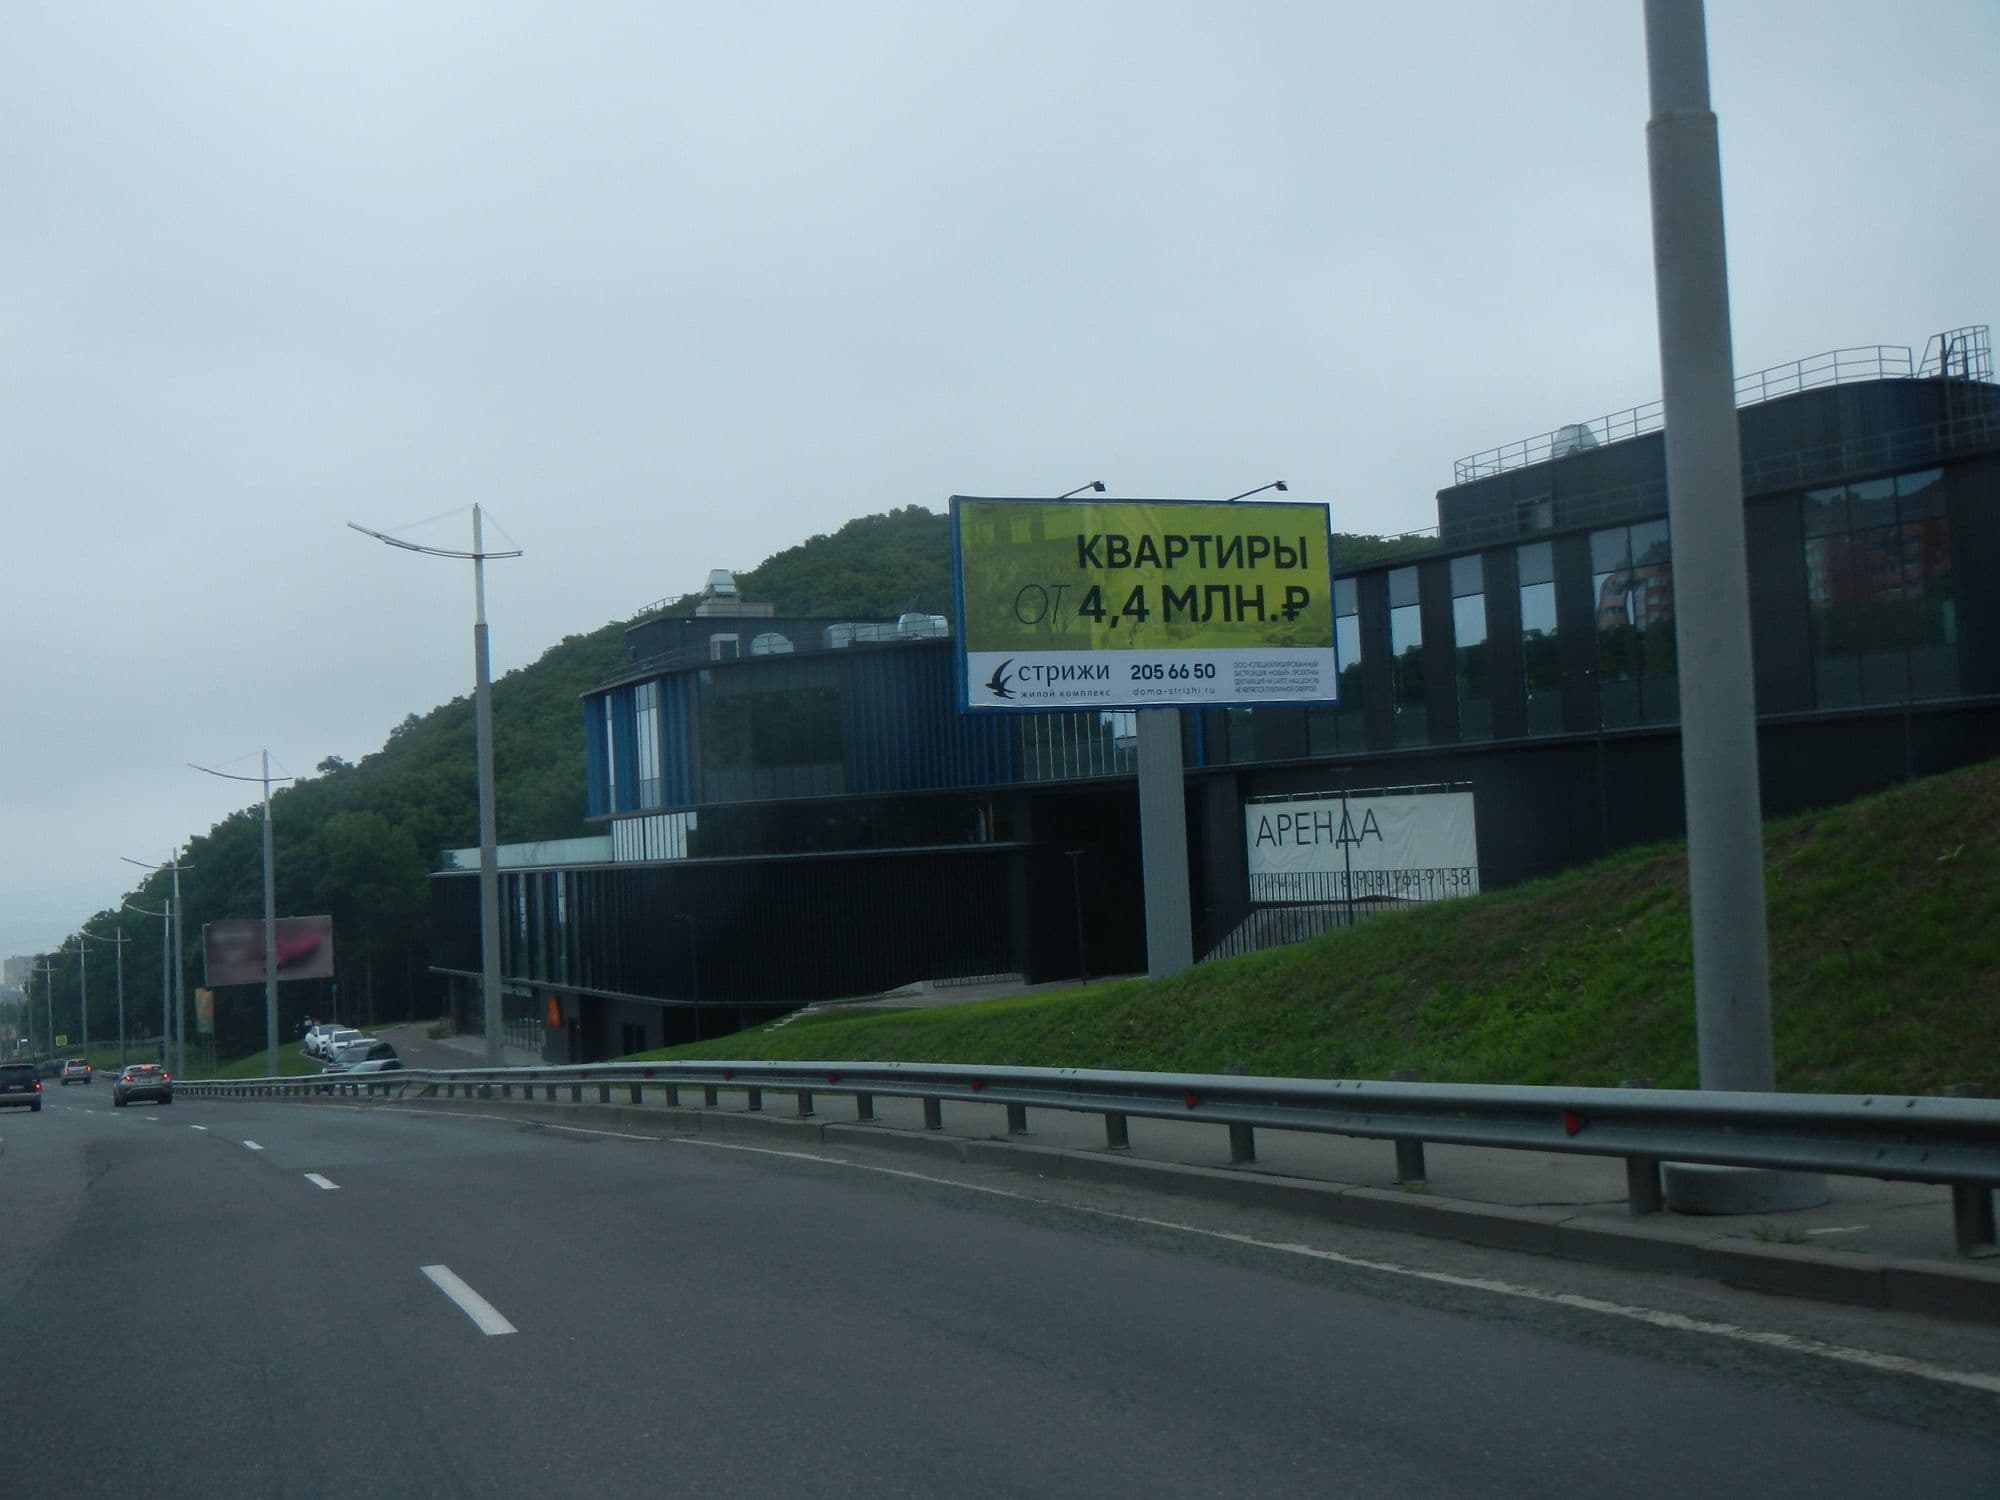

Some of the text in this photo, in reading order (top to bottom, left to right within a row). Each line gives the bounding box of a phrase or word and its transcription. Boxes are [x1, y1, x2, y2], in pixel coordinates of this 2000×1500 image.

[1077, 533, 1307, 569] КВАРТИРЫ
[1014, 583, 1071, 625] ОТ
[1078, 584, 1149, 628] 4,4
[1018, 662, 1110, 686] стрижи
[1130, 663, 1164, 680] 205
[1168, 663, 1189, 680] 66
[1193, 663, 1216, 679] 50
[1020, 688, 1110, 698] жилой комплекс
[1255, 808, 1383, 848] АРЕНДА
